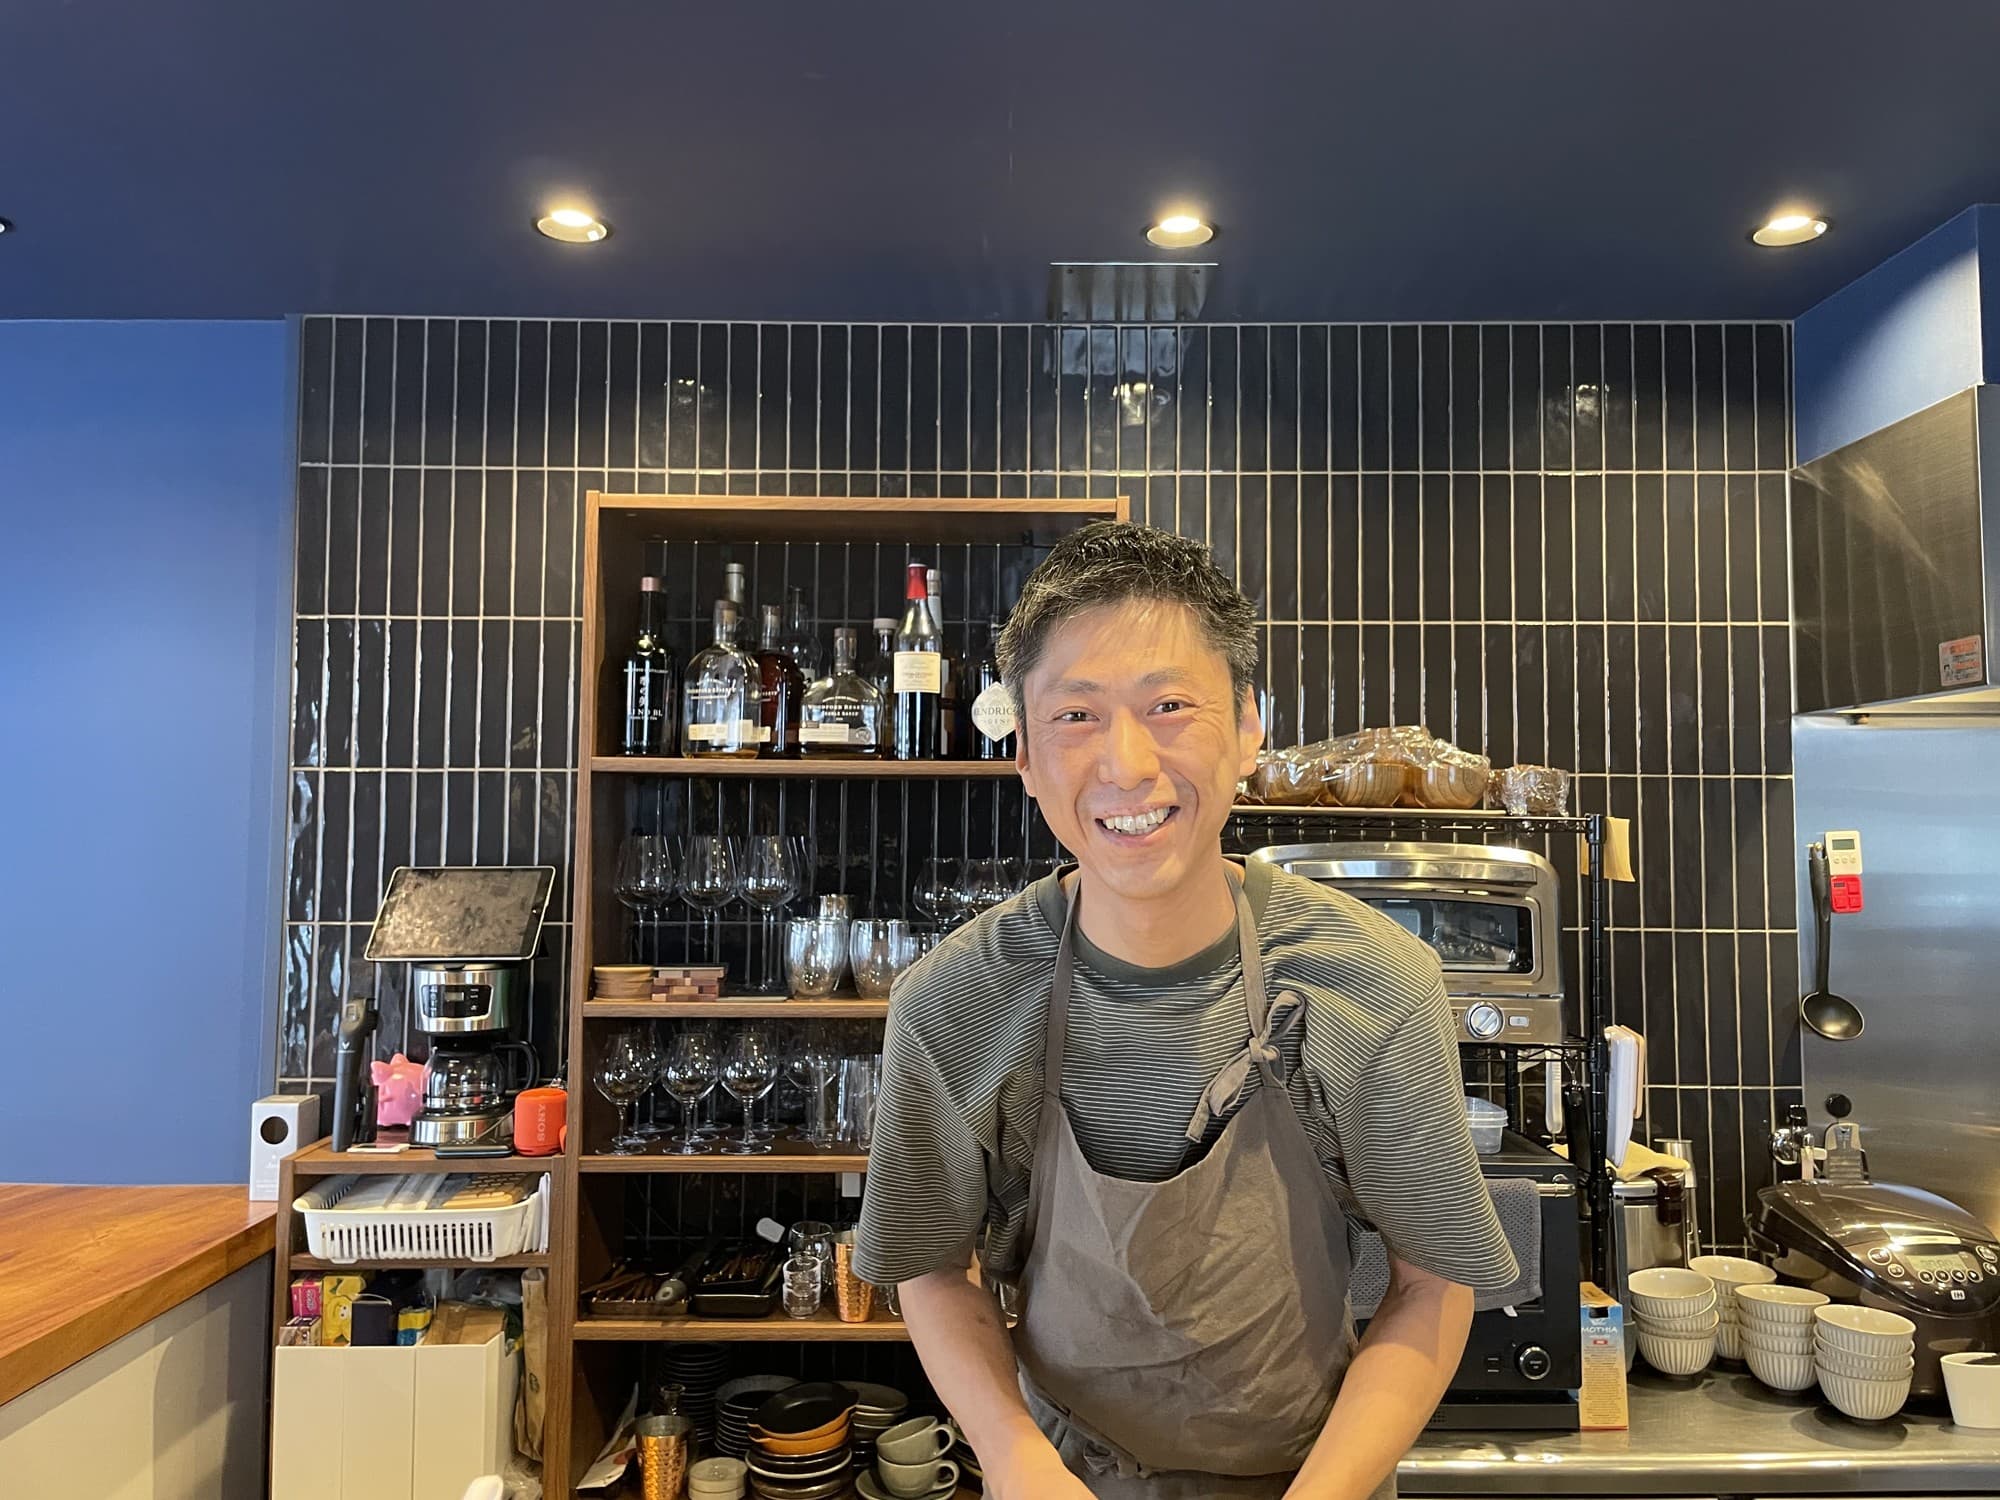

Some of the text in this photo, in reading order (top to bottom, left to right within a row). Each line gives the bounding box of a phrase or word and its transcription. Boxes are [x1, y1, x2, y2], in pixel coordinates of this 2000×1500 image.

[974, 705, 1014, 716] ENDRIC
[538, 1103, 546, 1142] SONY
[1581, 1326, 1618, 1334] MOTHIA
